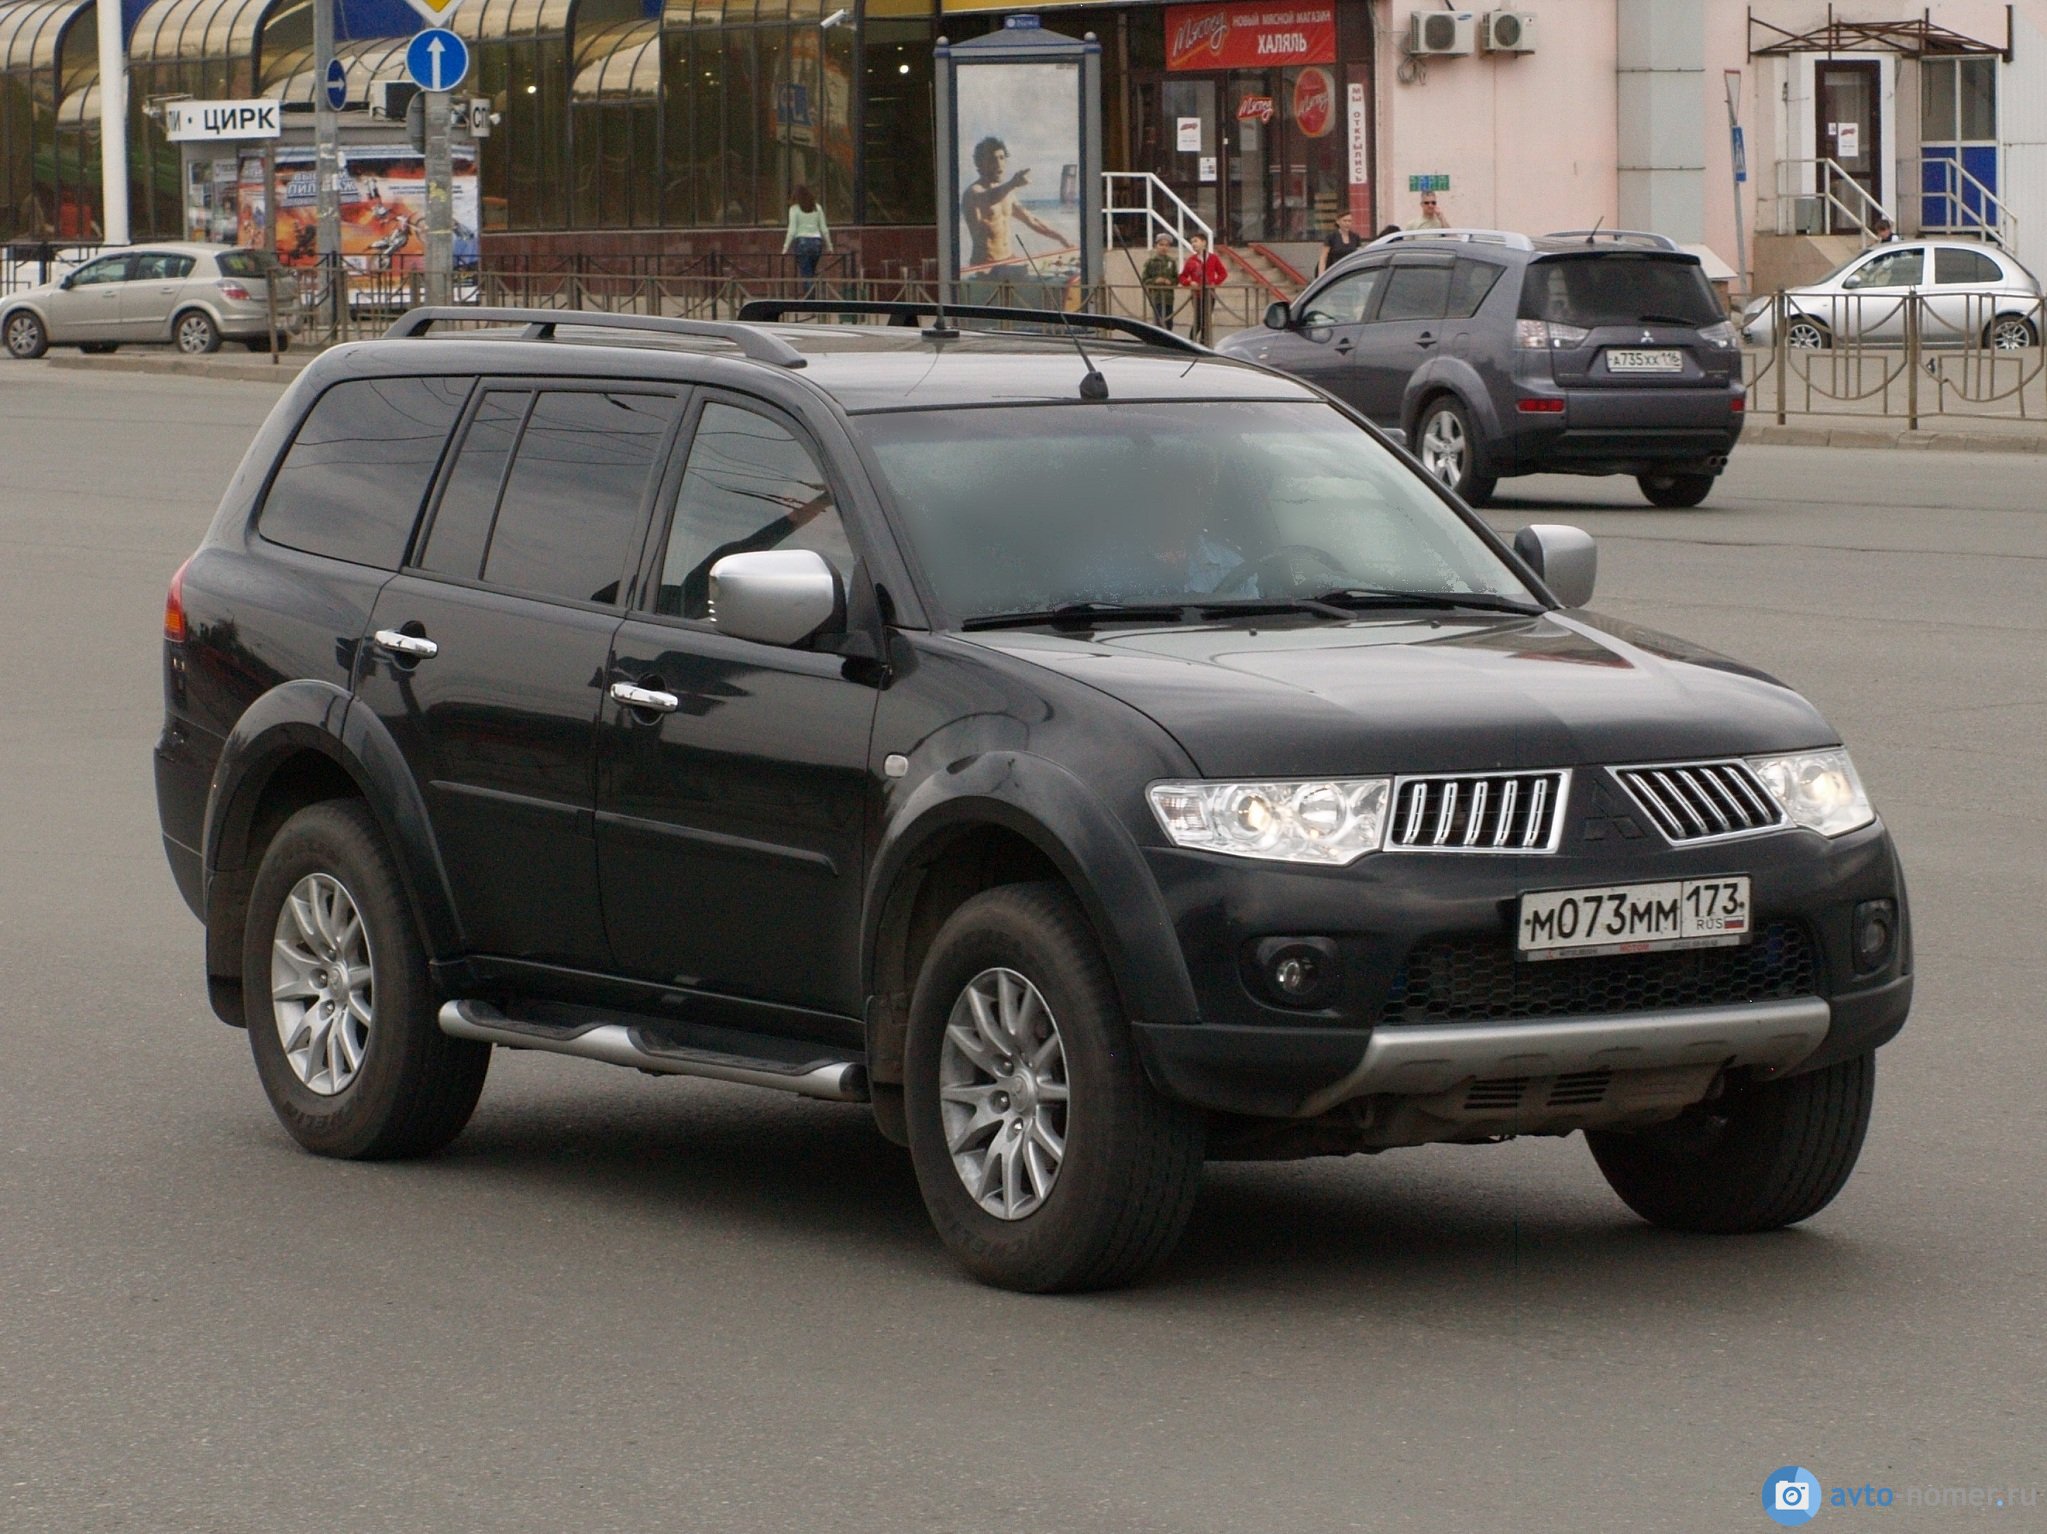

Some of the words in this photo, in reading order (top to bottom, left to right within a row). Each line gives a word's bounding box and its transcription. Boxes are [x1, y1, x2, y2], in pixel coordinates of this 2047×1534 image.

[1232, 12, 1259, 27] НОВЫЙ
[1296, 10, 1331, 24] МАГАЗИН
[1257, 33, 1307, 55] ХАЛЯЛЬ
[1352, 87, 1362, 102] МЫ
[204, 107, 275, 135] ЦИРК
[1353, 111, 1363, 183] ОТКРЫЛИСЬ
[1530, 893, 1679, 942] М073ММ
[1686, 883, 1740, 917] 173
[1696, 918, 1724, 930] RUS
